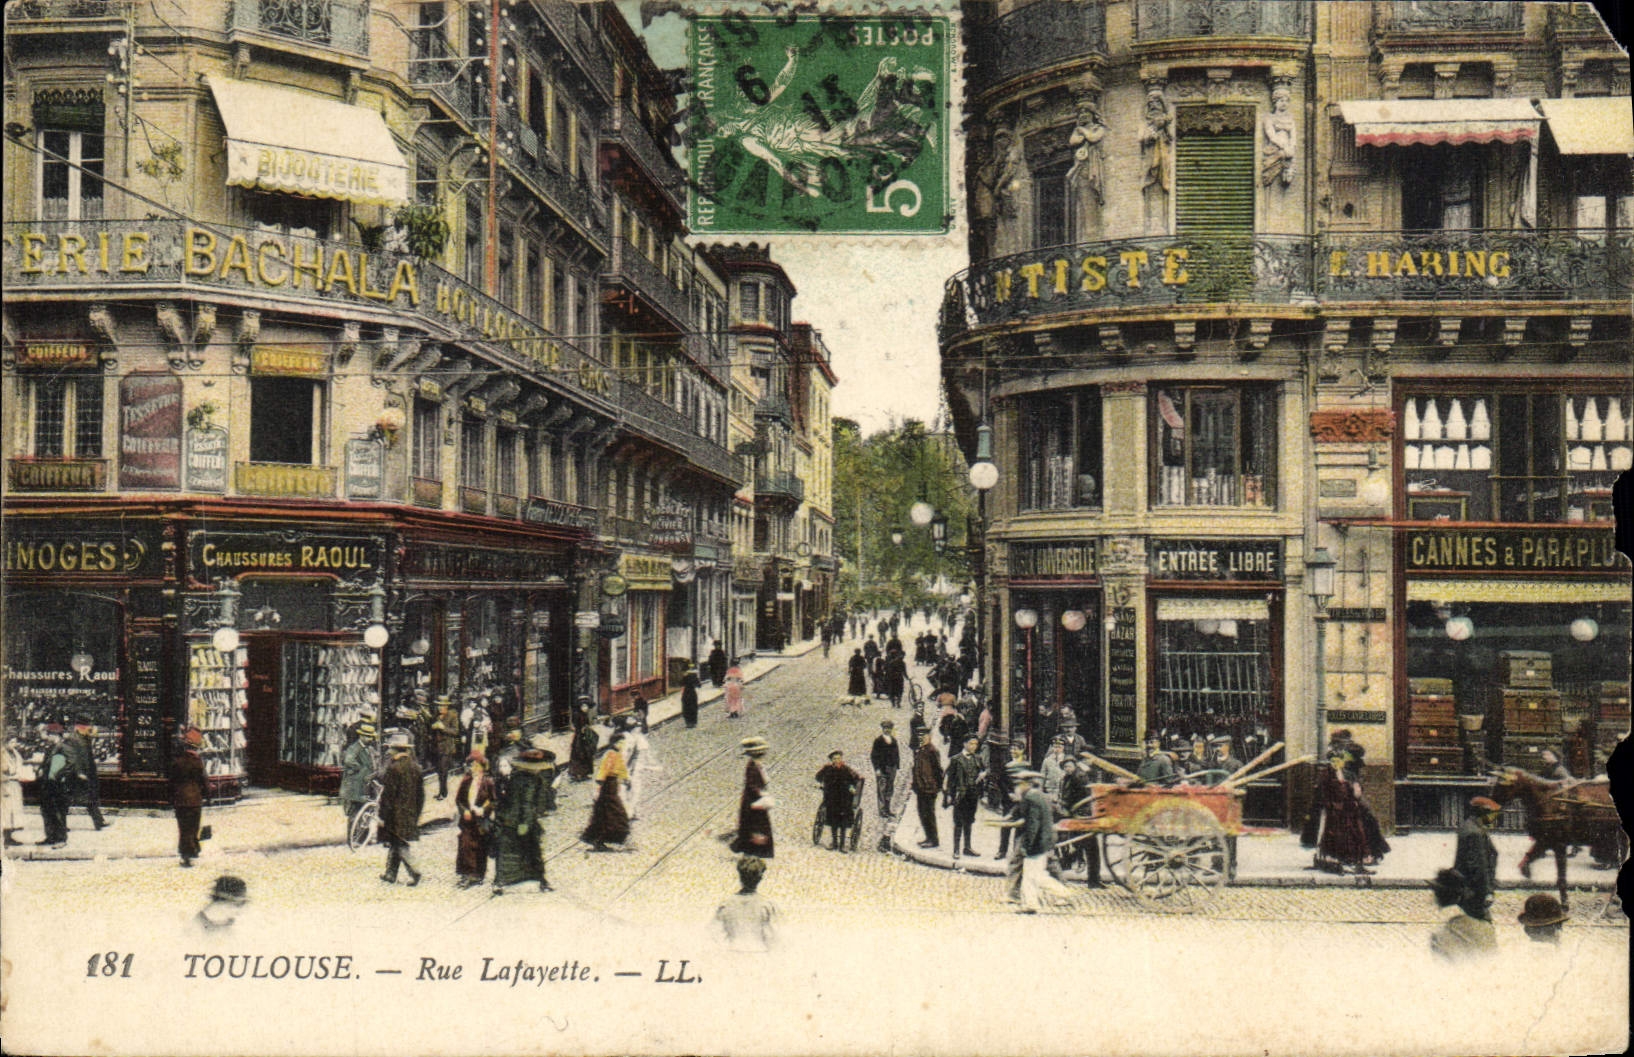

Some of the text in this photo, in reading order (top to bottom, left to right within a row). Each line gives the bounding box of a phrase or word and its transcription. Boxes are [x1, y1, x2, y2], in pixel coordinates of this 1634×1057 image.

[866, 179, 922, 217] 5
[185, 228, 420, 304] BACHALA
[1366, 251, 1511, 278] HARING
[28, 344, 88, 359] COIFFEUR
[20, 463, 94, 486] COIFFEUR
[300, 545, 372, 568] RAOUL
[1229, 551, 1275, 572] LIBRE
[1412, 537, 1497, 566] CANNES
[1504, 547, 1516, 566] &
[79, 665, 120, 683] Raoul
